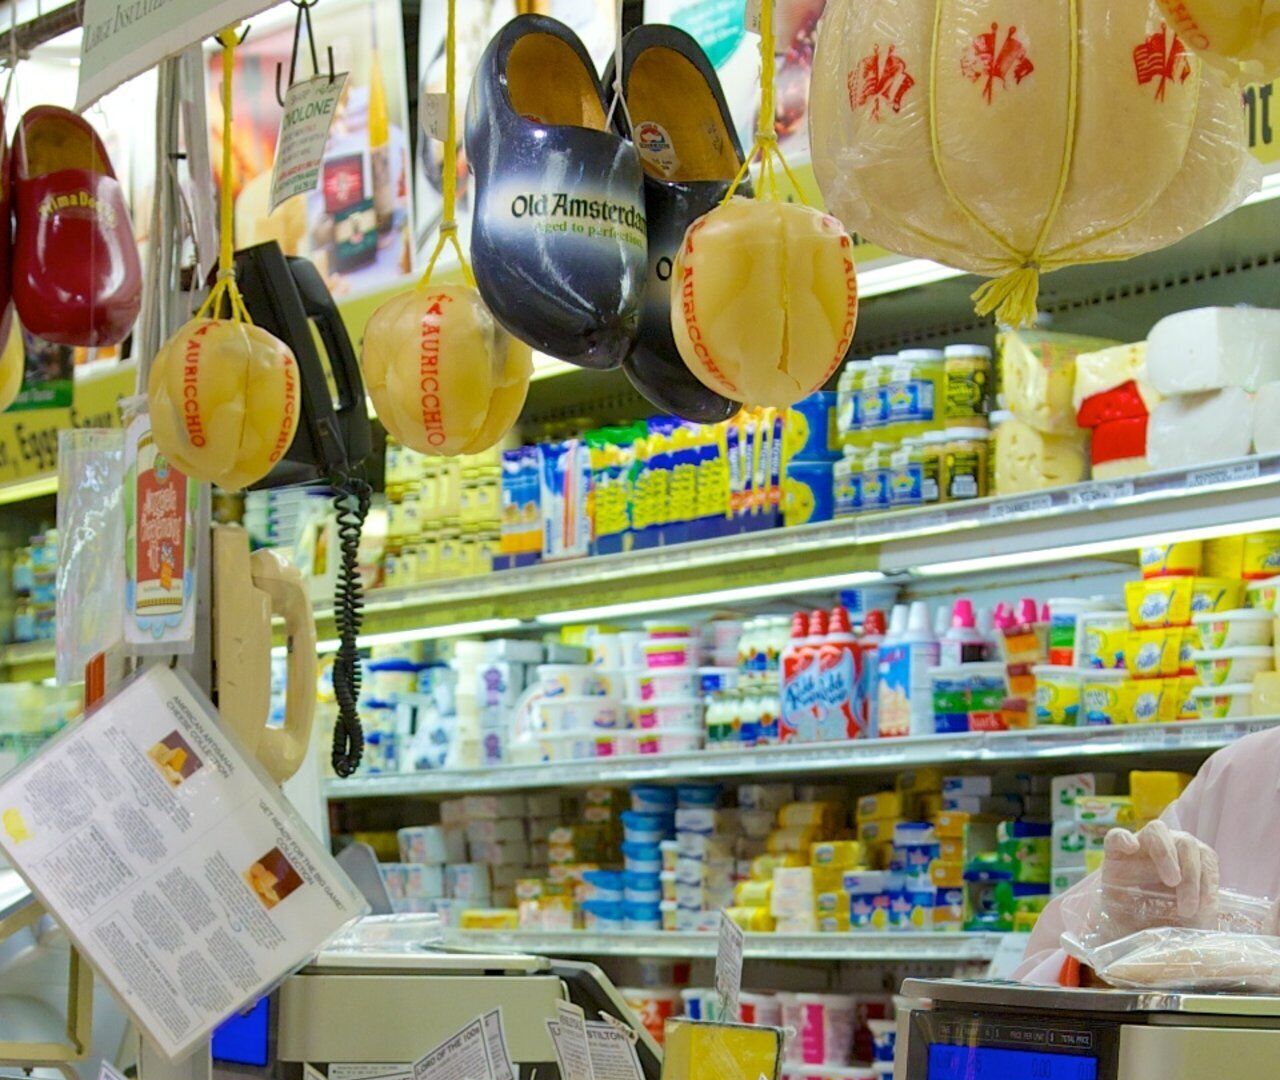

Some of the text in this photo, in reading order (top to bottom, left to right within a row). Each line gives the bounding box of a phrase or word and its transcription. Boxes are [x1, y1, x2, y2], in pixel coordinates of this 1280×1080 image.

[511, 195, 548, 218] Old
[572, 222, 584, 233] to
[183, 339, 206, 448] AURICCHIO
[421, 324, 445, 446] AURICCHIO
[173, 696, 205, 731] AMERICAN
[189, 729, 231, 778] COLLECTION
[275, 836, 316, 886] COLLECTION
